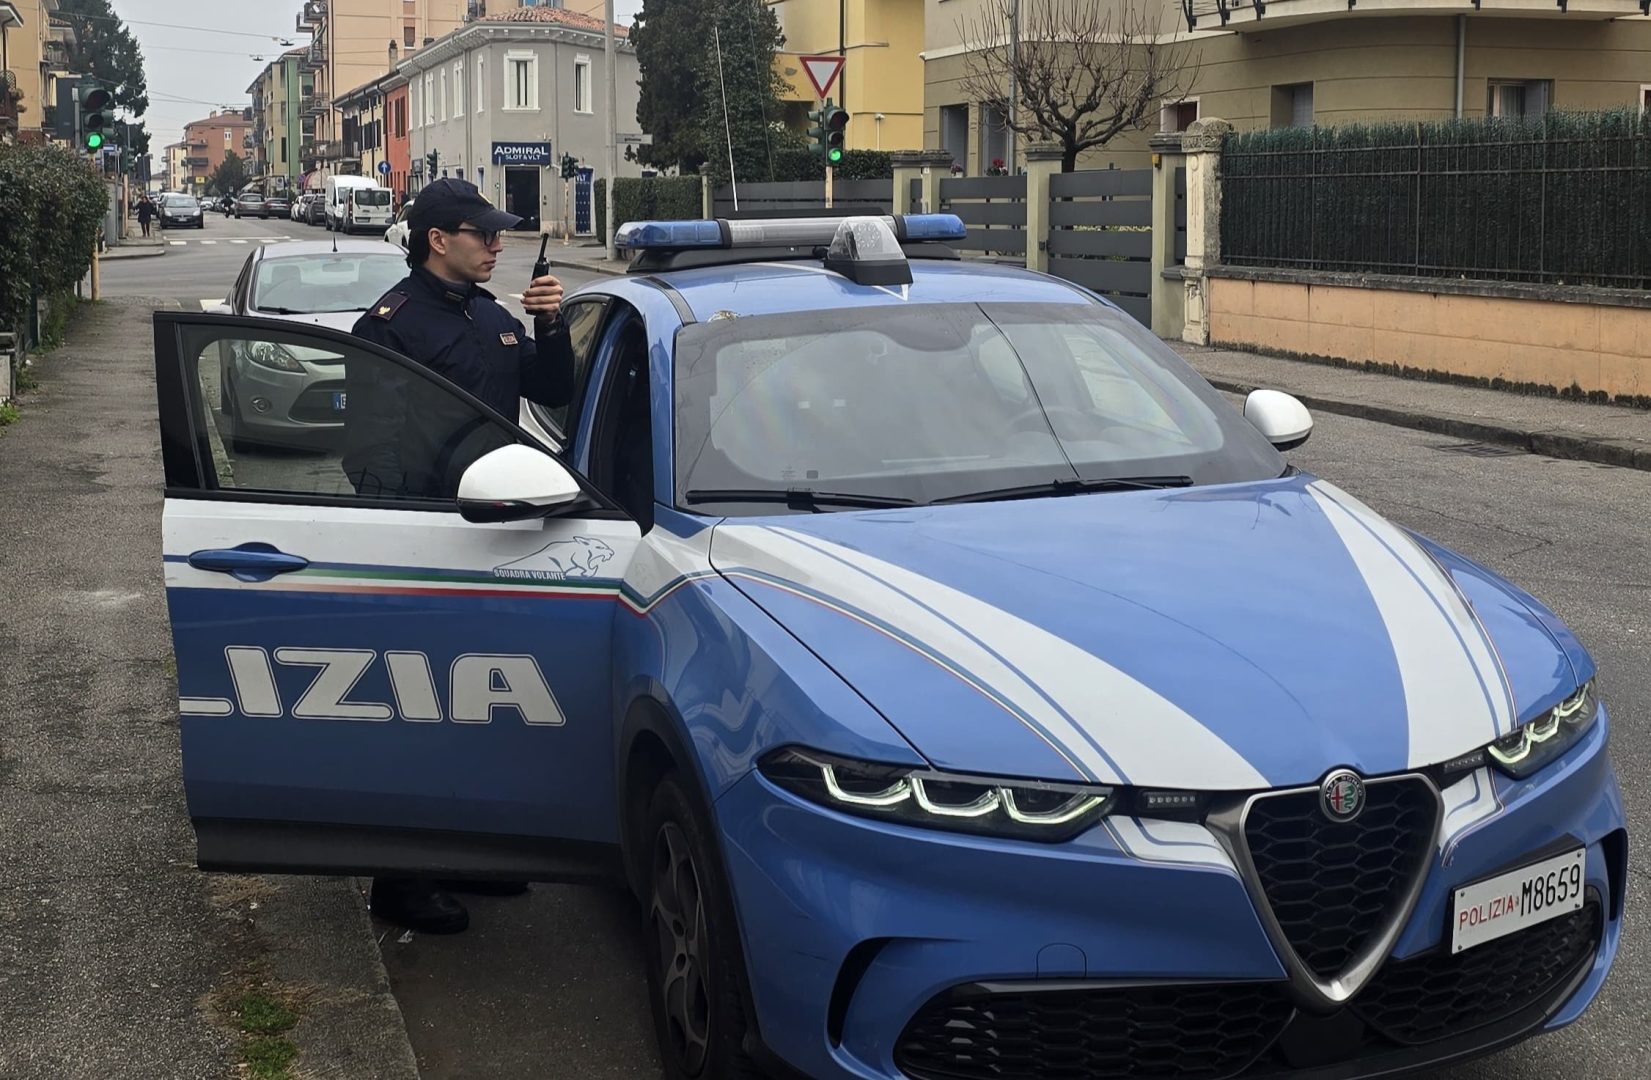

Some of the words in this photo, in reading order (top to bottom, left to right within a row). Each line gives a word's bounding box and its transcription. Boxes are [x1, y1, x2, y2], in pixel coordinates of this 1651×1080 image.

[494, 146, 548, 155] ADMIRAL
[494, 569, 531, 578] SQUADRA
[532, 571, 566, 580] VOLANTE
[1459, 895, 1514, 931] POLIZIA
[1520, 863, 1581, 917] M8659
